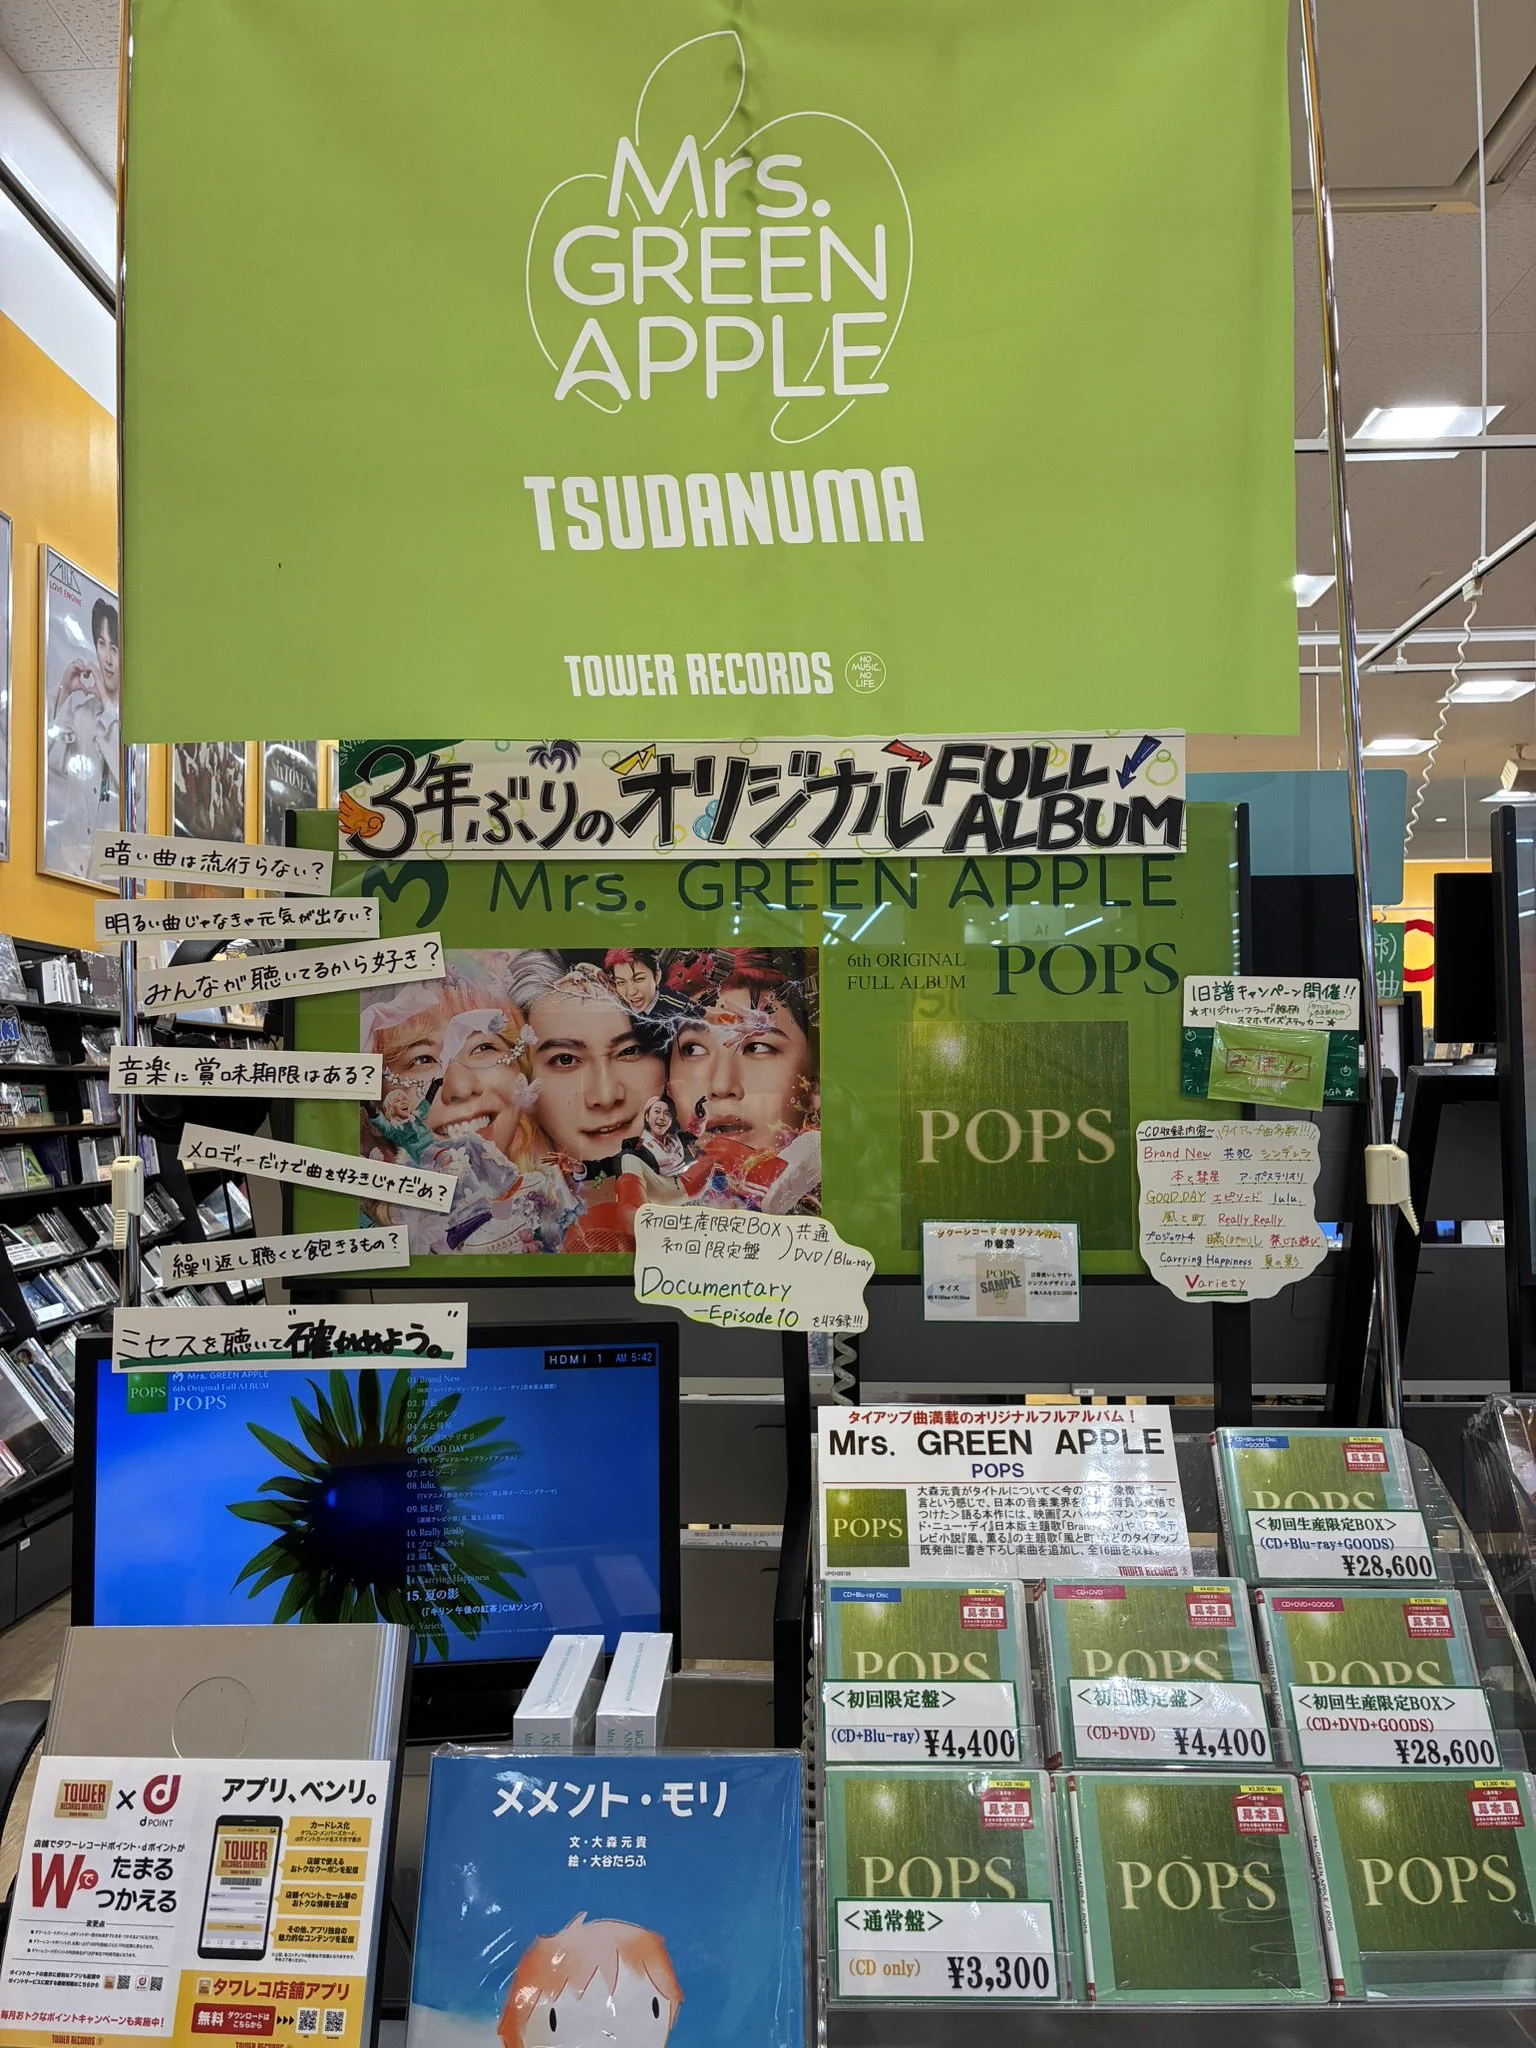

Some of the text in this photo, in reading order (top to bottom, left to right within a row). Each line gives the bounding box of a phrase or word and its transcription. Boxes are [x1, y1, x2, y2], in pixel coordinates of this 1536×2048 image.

[607, 135, 830, 219] Mrs.
[553, 224, 887, 305] GREEN
[554, 311, 889, 402] APPLE
[524, 466, 924, 551] TSUDANUMA
[860, 655, 872, 663] NO
[564, 651, 834, 698] TOWER RECORDS
[860, 671, 872, 679] NO
[856, 680, 875, 688] LIFE
[932, 743, 1112, 805] FULL
[944, 794, 1186, 853] ALBUM
[491, 857, 1178, 912] Mrs. GREEN APPLE
[847, 953, 967, 967] 6th ORIGINAL
[992, 943, 1180, 996] POPS
[847, 975, 967, 990] FULL ALBUM
[916, 1108, 1116, 1164] POPS
[1144, 1147, 1180, 1159] Brand
[1186, 1148, 1212, 1159] New
[1223, 1148, 1252, 1159] 共犯
[1146, 1190, 1179, 1203] GOOD
[1181, 1190, 1207, 1202] DAY
[1162, 1211, 1284, 1225] 風と町 Really Really
[1160, 1252, 1202, 1266] Carrying
[1206, 1253, 1252, 1266] Happiness
[640, 1266, 792, 1303] Documentary
[980, 1275, 1022, 1294] SAMPLE
[1185, 1274, 1247, 1290] Variety
[777, 1308, 799, 1326] 10
[549, 1352, 653, 1365] HDMI AM 5:42
[187, 1371, 269, 1380] Mrs. GREEN APPLE
[130, 1386, 166, 1399] POPS
[173, 1395, 227, 1411] POPS
[450, 1445, 465, 1453] DAY
[829, 1428, 1165, 1456] Mrs. GREEN APPLE
[971, 1463, 1024, 1478] POPS
[419, 1527, 441, 1537] Really
[833, 1517, 903, 1539] POPS
[1118, 1566, 1144, 1577] TOWER
[1342, 1554, 1433, 1578] ¥28,600
[407, 1591, 422, 1602] 15.
[876, 1591, 889, 1599] Disc
[1281, 1600, 1335, 1608] CD+DVD+GOODS
[1306, 1716, 1434, 1733] (CD+DVD+GOODS)
[831, 1728, 1016, 1759] (CD+Blu-ray) ¥4,400
[1087, 1725, 1266, 1757] (CD+DVD) ¥4,400
[1394, 1739, 1495, 1766] ¥28,600
[64, 1783, 107, 1803] TOWER
[221, 1778, 377, 1805] アプリ、ベンリ。
[492, 1781, 727, 1818] メメント・モリ
[988, 1803, 1025, 1815] 見本品
[1243, 1808, 1280, 1820] 見本品
[1478, 1802, 1515, 1814] 見本品
[139, 1816, 174, 1828] d POINT
[311, 1821, 350, 1830] カードレス化
[224, 1840, 268, 1861] TOWER
[307, 1857, 344, 1865] 店舗で使える
[568, 1854, 647, 1868] 絵・大谷たらふ
[290, 1865, 359, 1874] おトクなクーポンを配信
[860, 1856, 1017, 1899] POPS
[32, 1853, 174, 1909] W で たまる
[1117, 1860, 1276, 1911] POPS
[1357, 1854, 1518, 1907] POPS
[285, 1891, 357, 1900] 店舗イベント、セール等の
[1315, 1851, 1334, 1932] GREEN APPLE POPS
[95, 1888, 177, 1913] つかえる
[292, 1900, 349, 1909] おトクな情報を配信
[287, 1926, 347, 1935] その他、アプリ独自の
[278, 1934, 354, 1944] 魅力的なコンテンツを配信
[848, 1956, 1050, 1992] (CD only) ¥3,300
[213, 1978, 350, 2001] タワレコ店舗アプリ
[197, 2011, 270, 2027] 無料 ダウンロードは
[233, 2020, 262, 2029] こちらから
[52, 2034, 96, 2046] TOWER RECORDS
